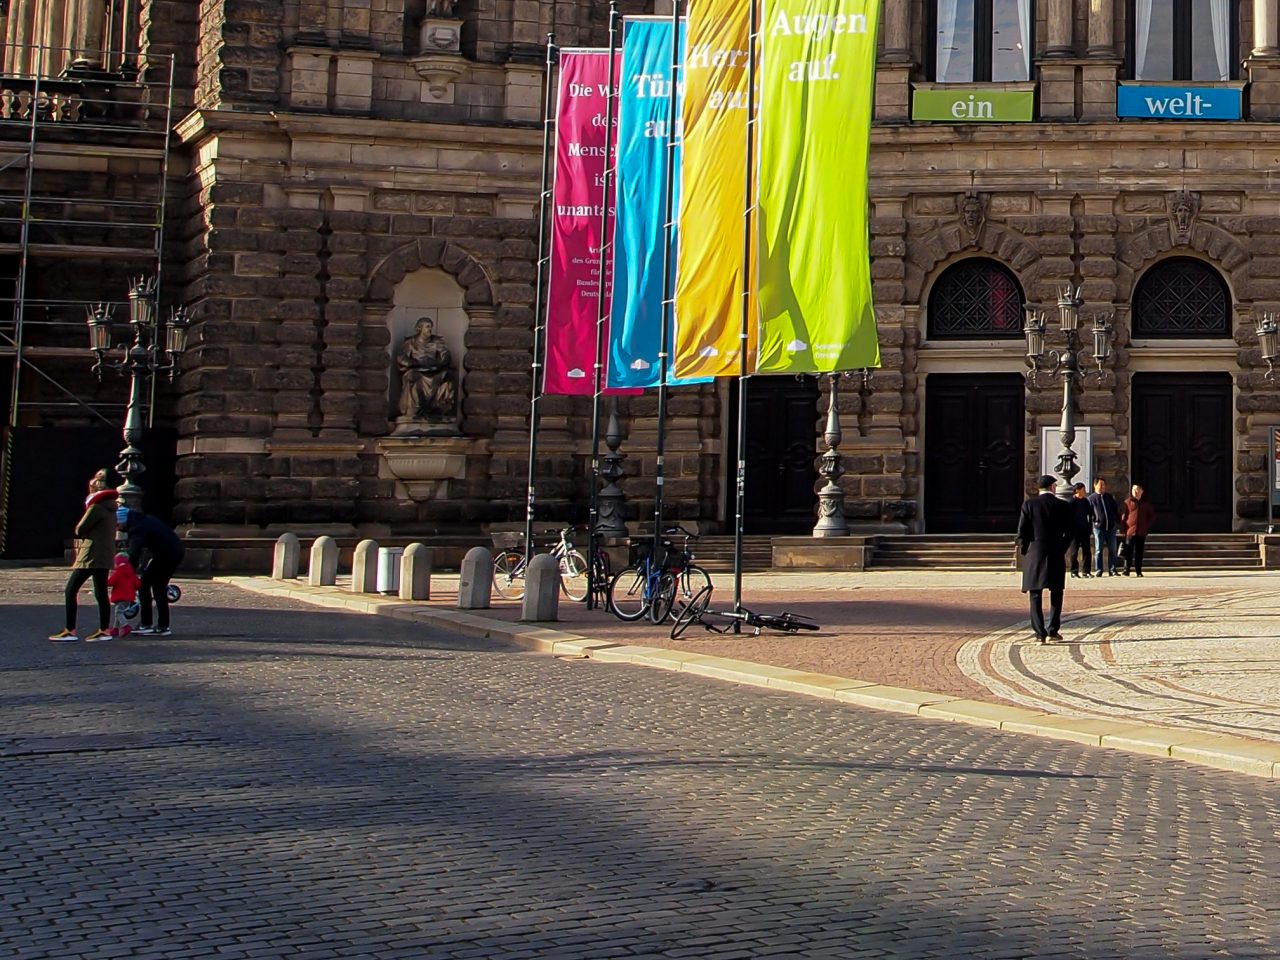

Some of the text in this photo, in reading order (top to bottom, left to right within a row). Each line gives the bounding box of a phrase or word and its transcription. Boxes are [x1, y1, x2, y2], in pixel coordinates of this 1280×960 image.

[772, 9, 867, 41] Augen
[788, 53, 840, 82] auf.
[569, 83, 593, 97] Die
[951, 95, 993, 119] ein
[1144, 92, 1212, 117] welt-
